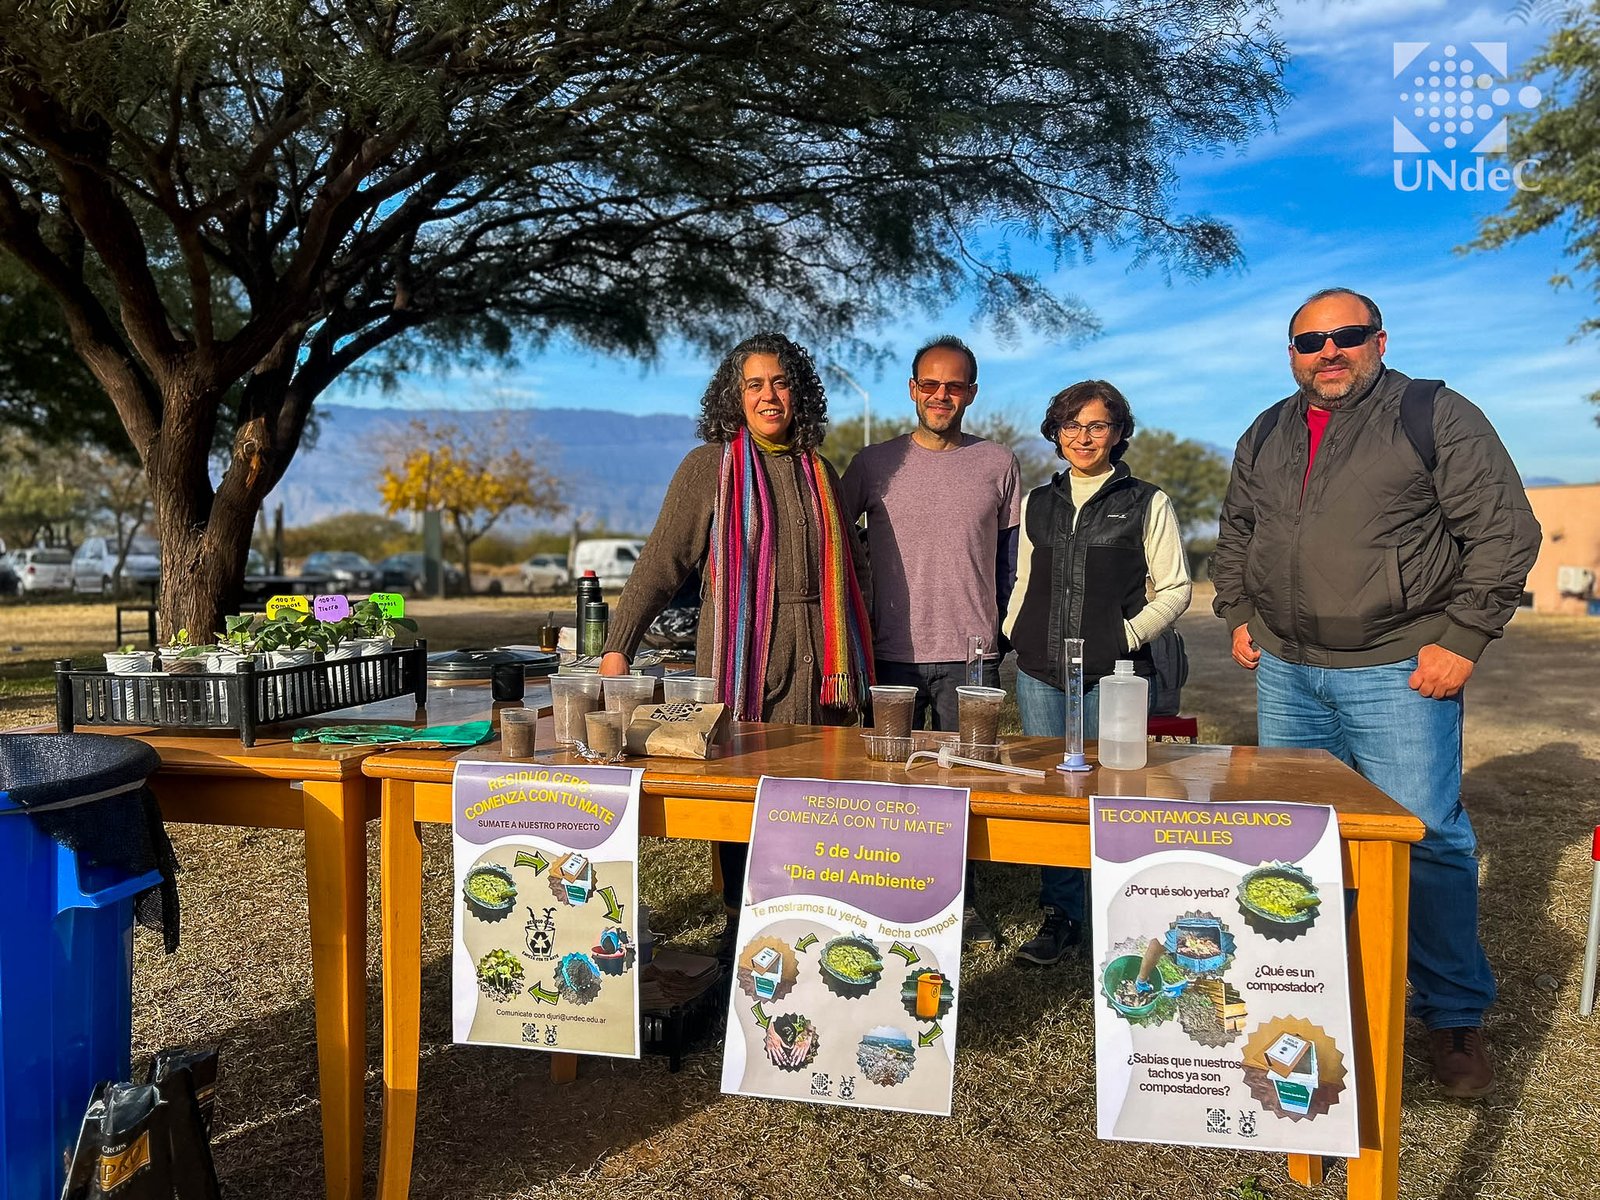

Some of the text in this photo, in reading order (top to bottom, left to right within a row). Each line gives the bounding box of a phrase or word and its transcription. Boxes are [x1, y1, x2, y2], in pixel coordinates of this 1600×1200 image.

[650, 713, 696, 722] UNdeC
[487, 770, 550, 792] RESIDUO
[464, 785, 616, 826] COMENZÁ CON TU MATE
[802, 795, 921, 815] “RESIDUO CERO:
[477, 819, 600, 832] SUMATE A NUESTRO PROYECTO
[768, 809, 952, 835] COMENZÁ CON TU MATE”
[1098, 808, 1292, 827] TE CONTAMOS ALGUNOS
[1154, 829, 1233, 845] DETALLES
[815, 842, 901, 863] 5 de Junio
[783, 864, 935, 891] “Día del Ambiente”
[1124, 884, 1230, 900] ¿Por qué solo yerba?
[752, 902, 959, 938] Te mostramos tu yerba hecha compost
[1254, 965, 1315, 978] ¿Qué es un
[1246, 980, 1325, 994] compostador?
[496, 1008, 533, 1018] Comunicate
[1127, 1052, 1241, 1069] ¿Sabías que nuestros
[1147, 1067, 1221, 1082] tachos ya son
[1139, 1082, 1230, 1096] compostadores?
[102, 1143, 127, 1154] CROPS
